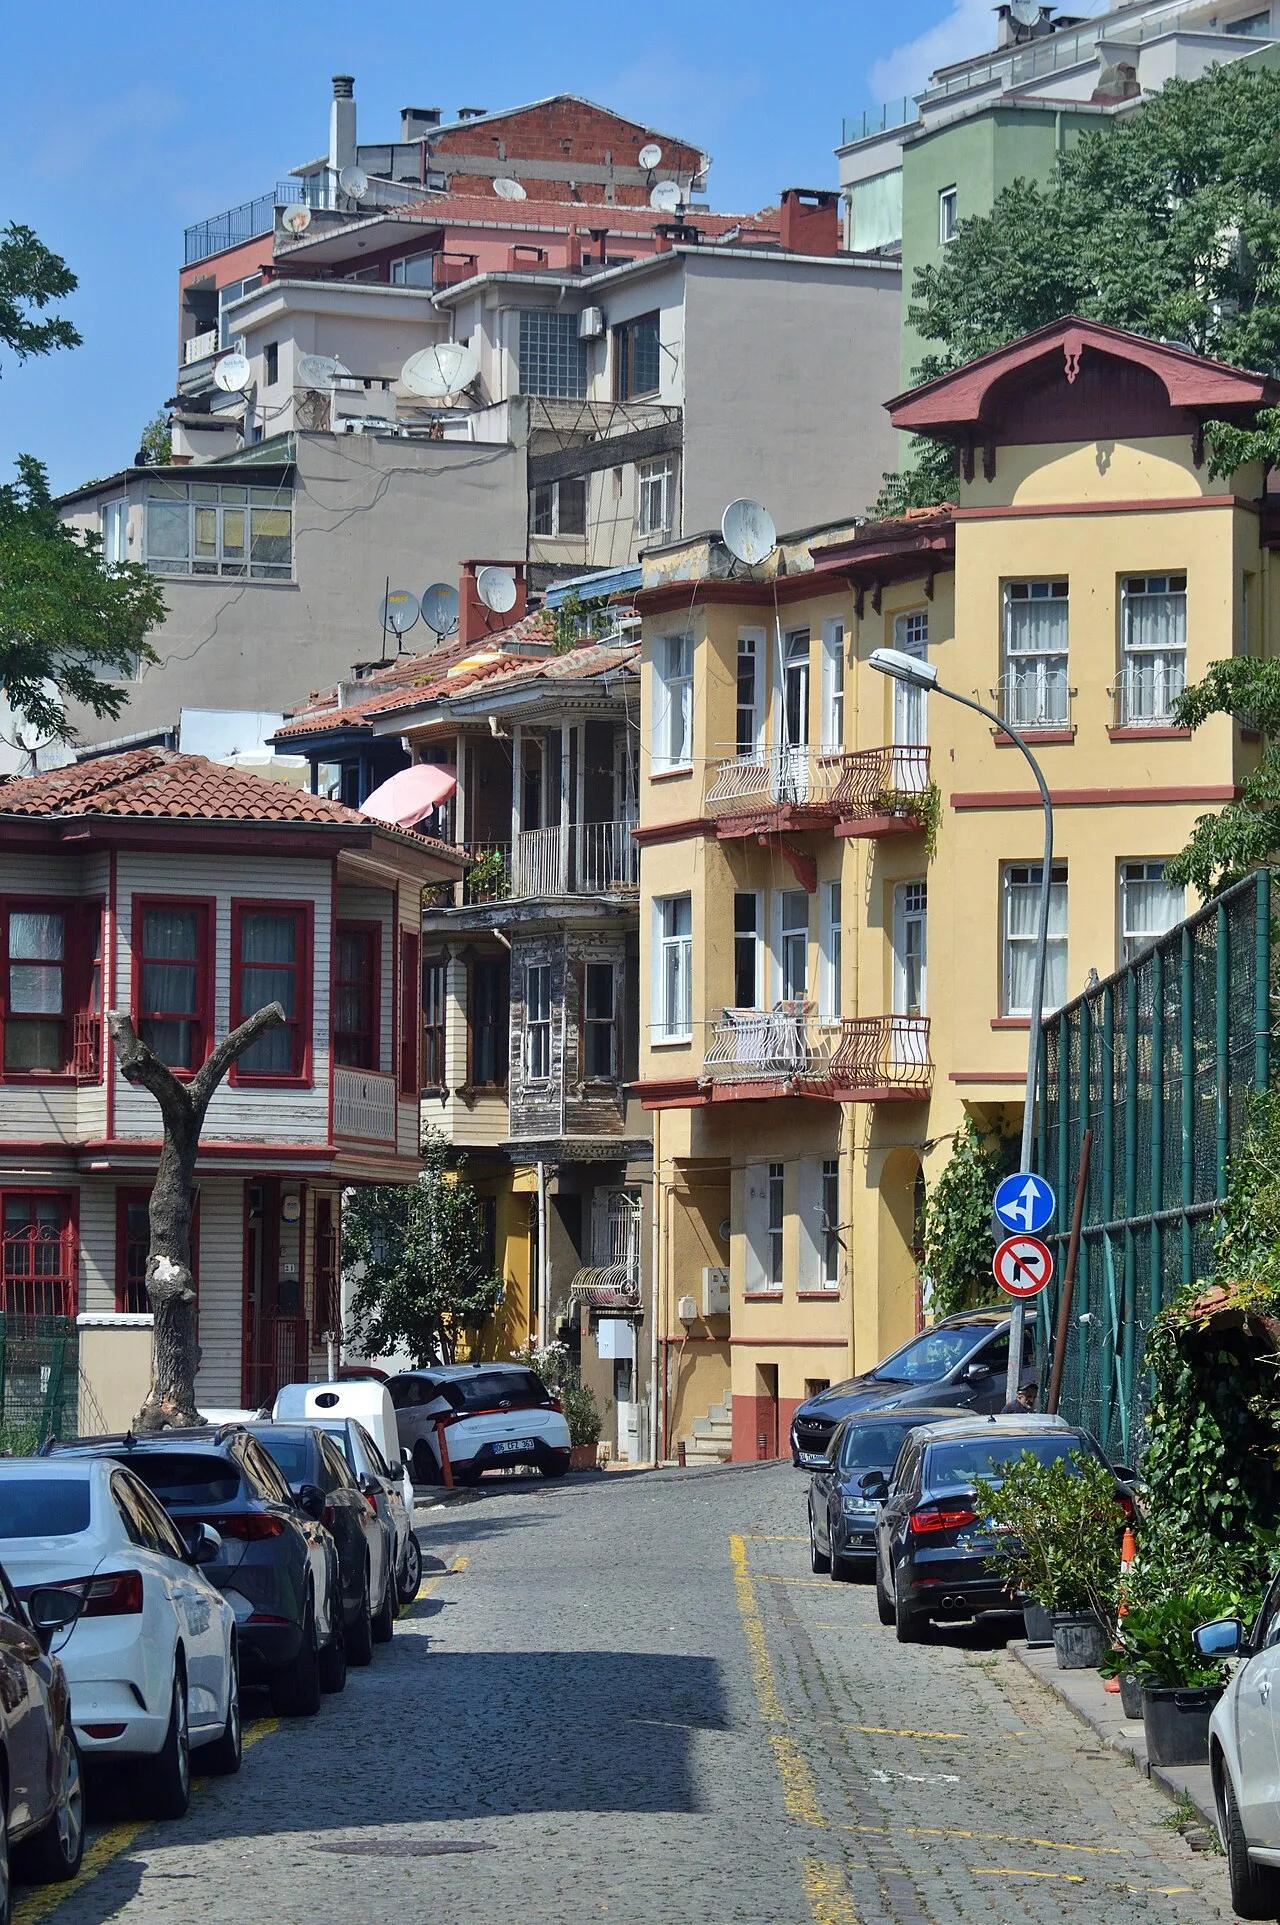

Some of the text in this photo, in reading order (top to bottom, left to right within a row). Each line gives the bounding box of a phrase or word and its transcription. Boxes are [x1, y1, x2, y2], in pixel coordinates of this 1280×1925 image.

[285, 1264, 294, 1272] 21
[496, 1439, 534, 1452] 06 CFZ 363
